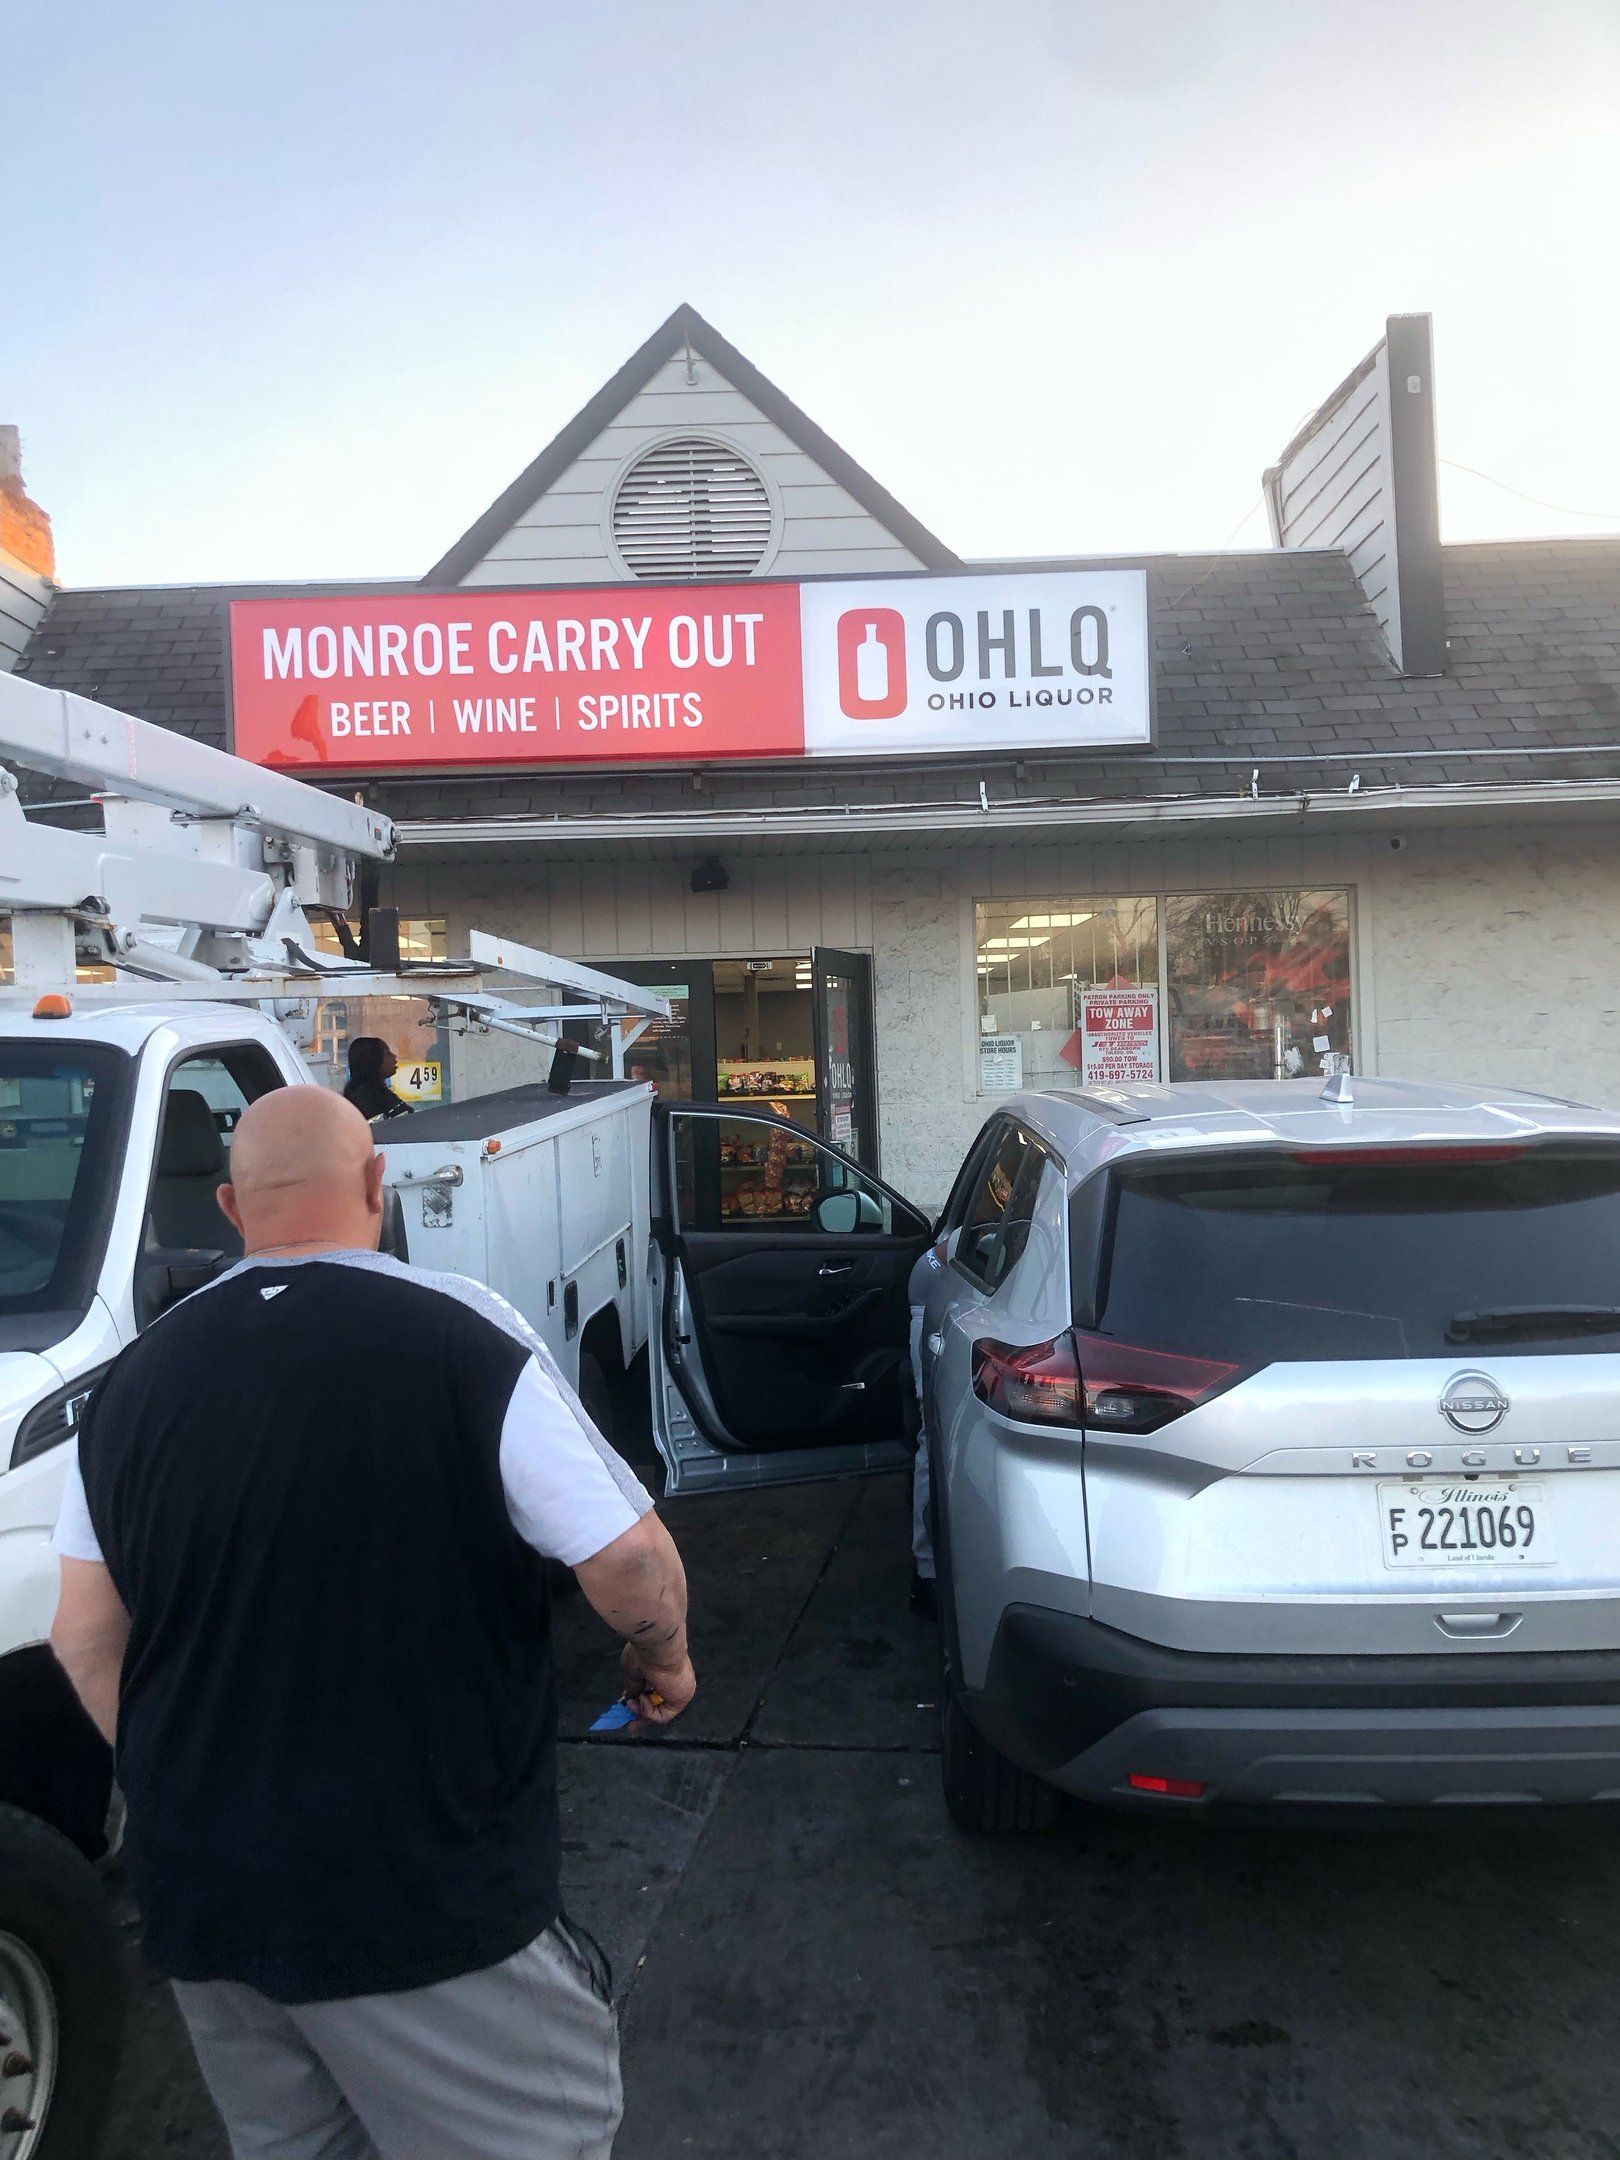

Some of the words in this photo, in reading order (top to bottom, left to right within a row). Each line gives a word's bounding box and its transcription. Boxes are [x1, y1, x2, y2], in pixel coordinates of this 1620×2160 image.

[262, 622, 475, 681] MONROE
[488, 616, 653, 675] CARRY
[668, 612, 765, 670] OUT
[925, 604, 1114, 683] OHLQ
[927, 690, 997, 712] OHIO
[1008, 686, 1114, 708] LIQUOR
[330, 699, 412, 737] BEER
[452, 696, 538, 734] WINE
[577, 692, 704, 731] SPIRITS
[1206, 912, 1303, 935] Hennessy
[1089, 1008, 1114, 1019] TOW
[1116, 1007, 1149, 1018] AWAY
[1105, 1018, 1134, 1030] ZONE
[998, 1046, 1017, 1054] HOURS
[831, 1062, 852, 1089] OHLQ
[1087, 1069, 1154, 1080] 419-697-5724
[1442, 1400, 1509, 1411] NISSAN
[1351, 1446, 1592, 1469] ROGUE
[1419, 1487, 1509, 1505] Illinois
[1418, 1505, 1535, 1550] 221069
[1447, 1554, 1464, 1562] Land
[1464, 1554, 1471, 1562] of
[1471, 1554, 1495, 1562] Lincoln
